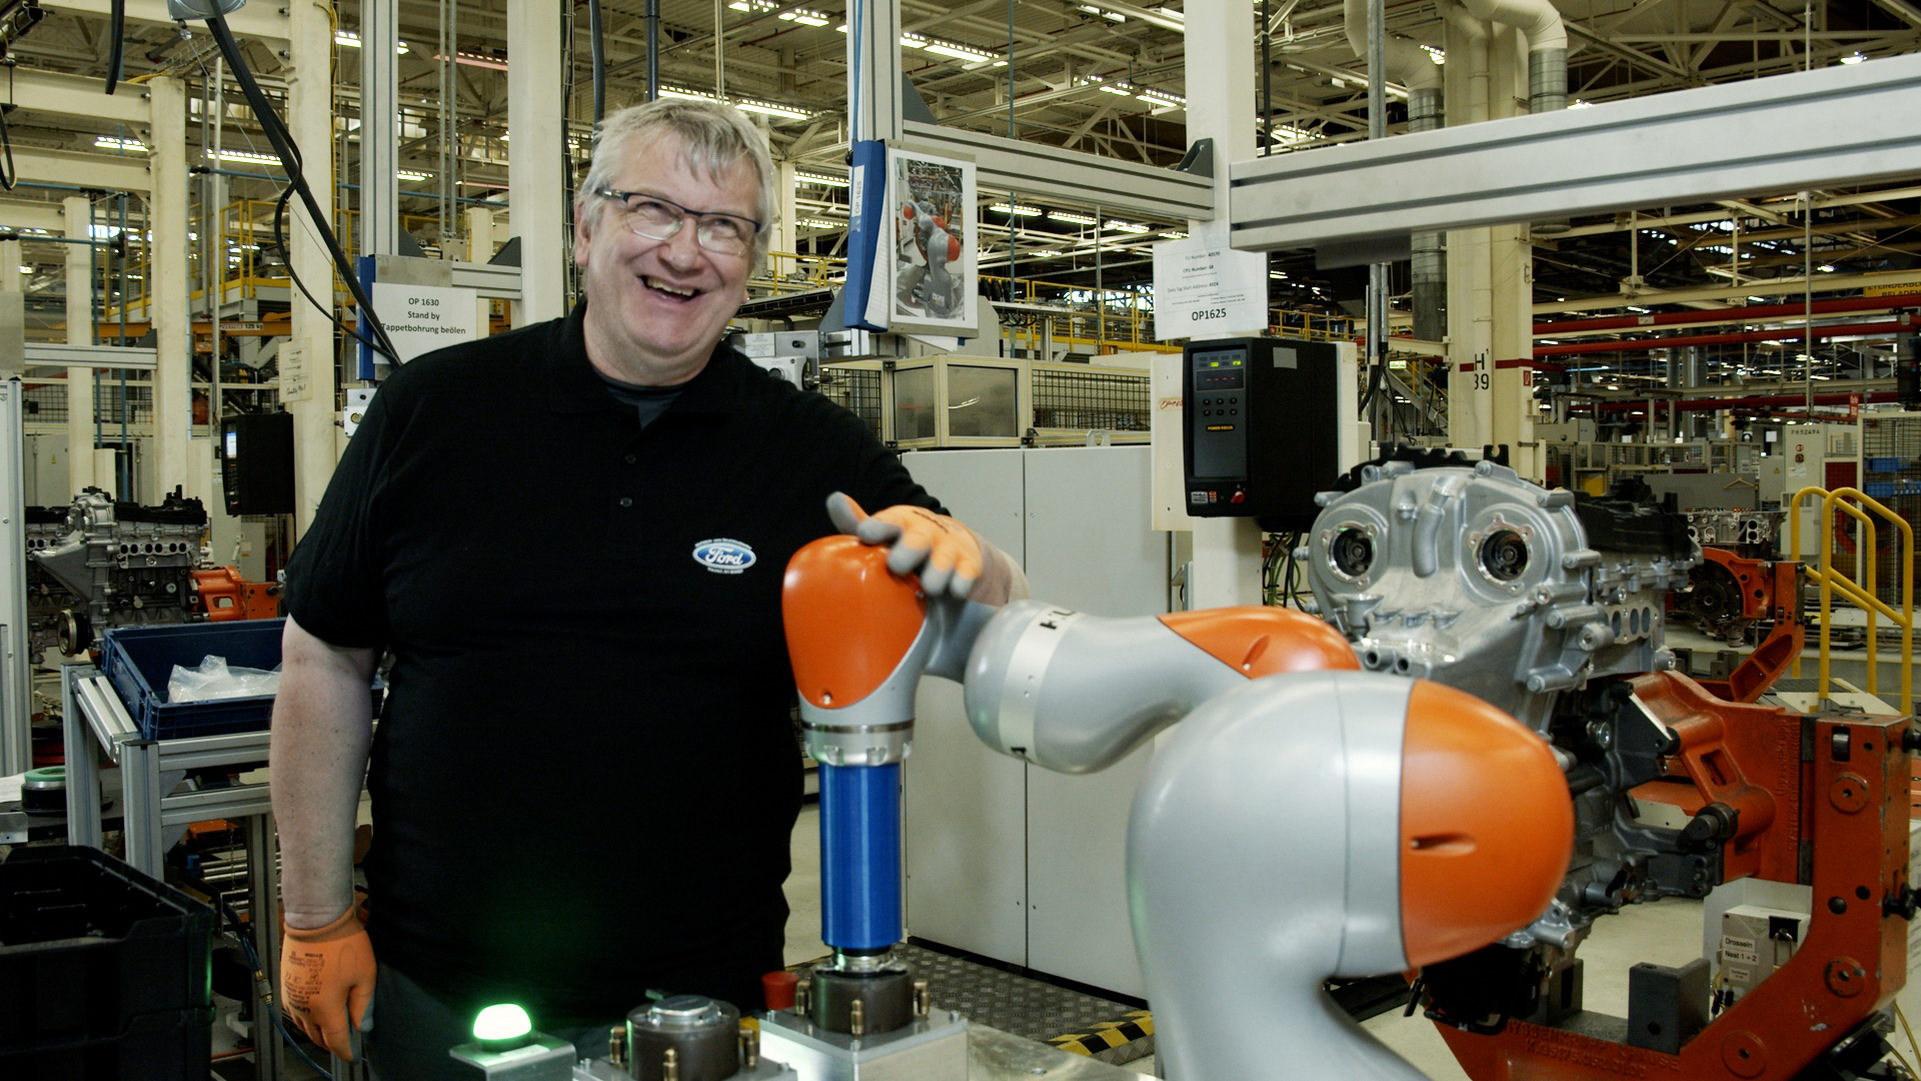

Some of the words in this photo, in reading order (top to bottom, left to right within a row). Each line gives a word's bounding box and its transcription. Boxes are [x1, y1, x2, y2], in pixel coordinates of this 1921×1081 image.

[408, 297, 420, 305] OP
[421, 298, 440, 306] 1630
[407, 310, 429, 320] Stand
[430, 311, 440, 321] by
[1191, 308, 1227, 321] OP1625
[380, 323, 439, 334] Tappetbohrung
[440, 325, 466, 334] beölen
[705, 546, 744, 565] Ford
[1725, 937, 1753, 948] Drosseln
[1725, 951, 1739, 959] Nest
